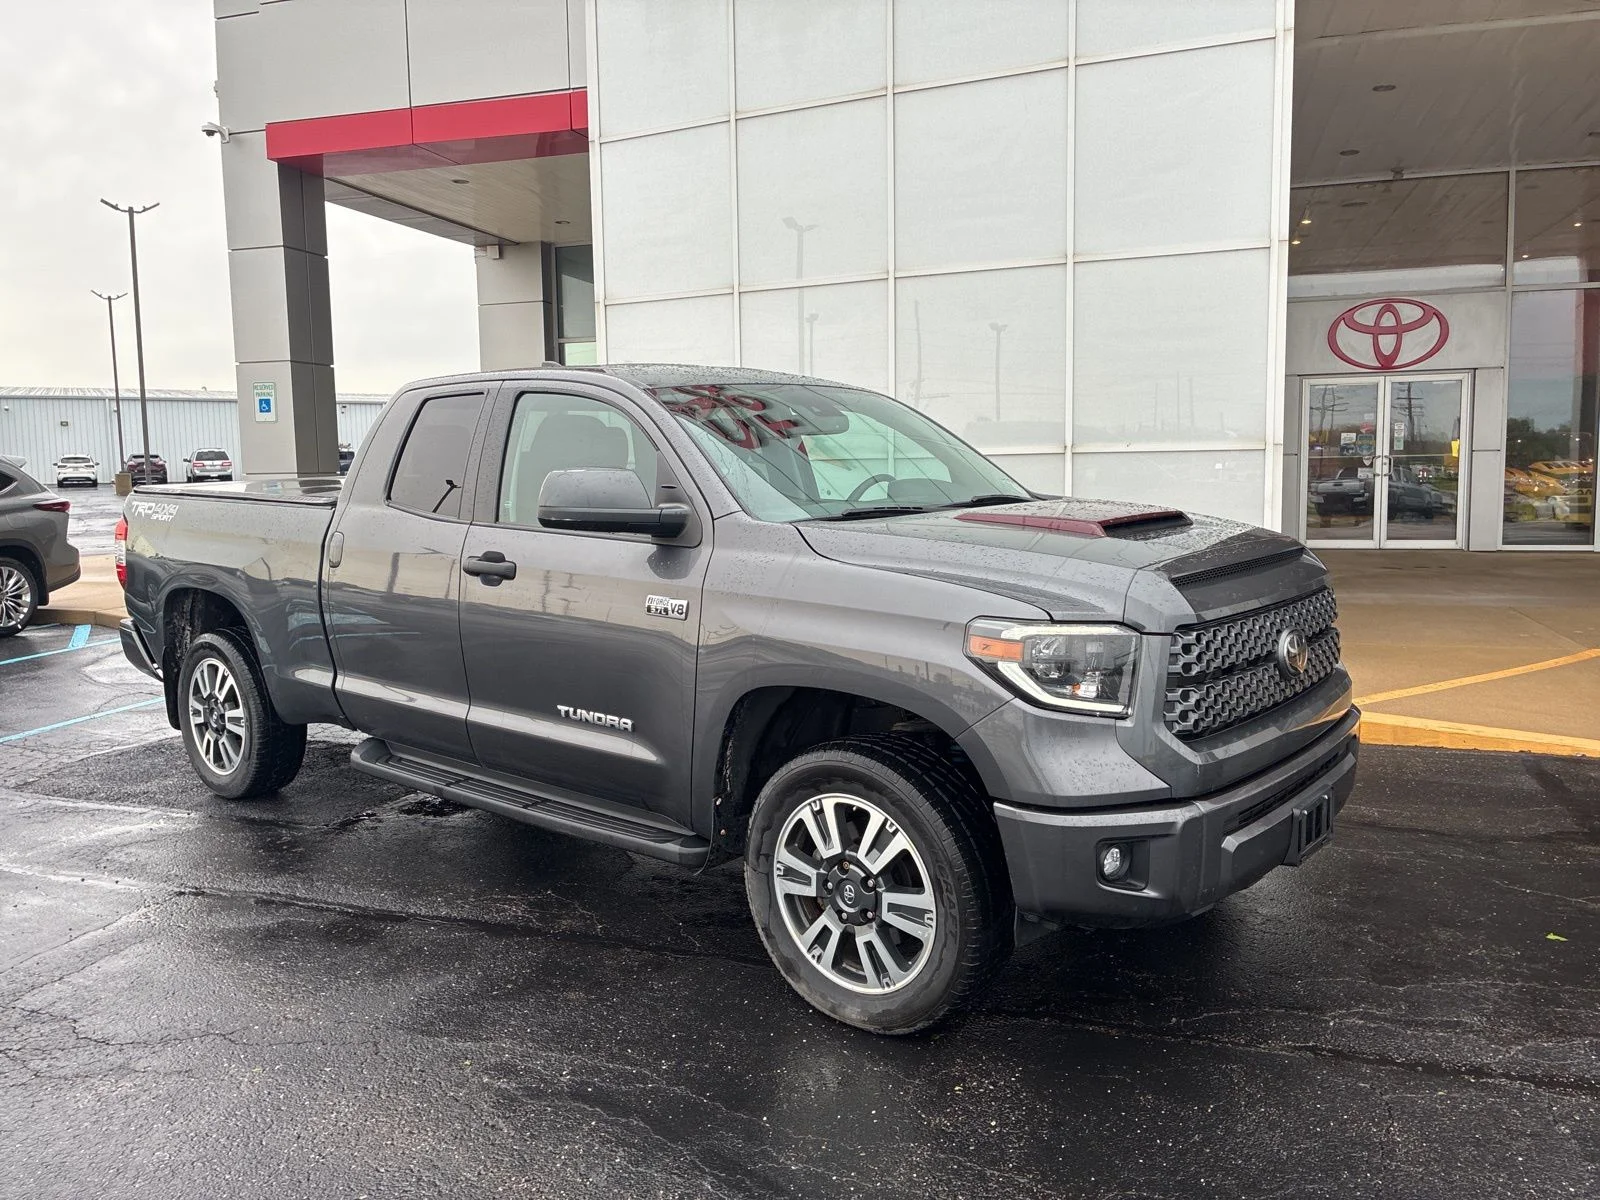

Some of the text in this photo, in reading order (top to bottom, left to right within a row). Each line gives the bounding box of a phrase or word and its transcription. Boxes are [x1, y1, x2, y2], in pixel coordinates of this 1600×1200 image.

[131, 501, 156, 517] TRD
[150, 513, 174, 521] SPORT
[670, 602, 685, 616] V8
[556, 704, 633, 732] TUNDRA
